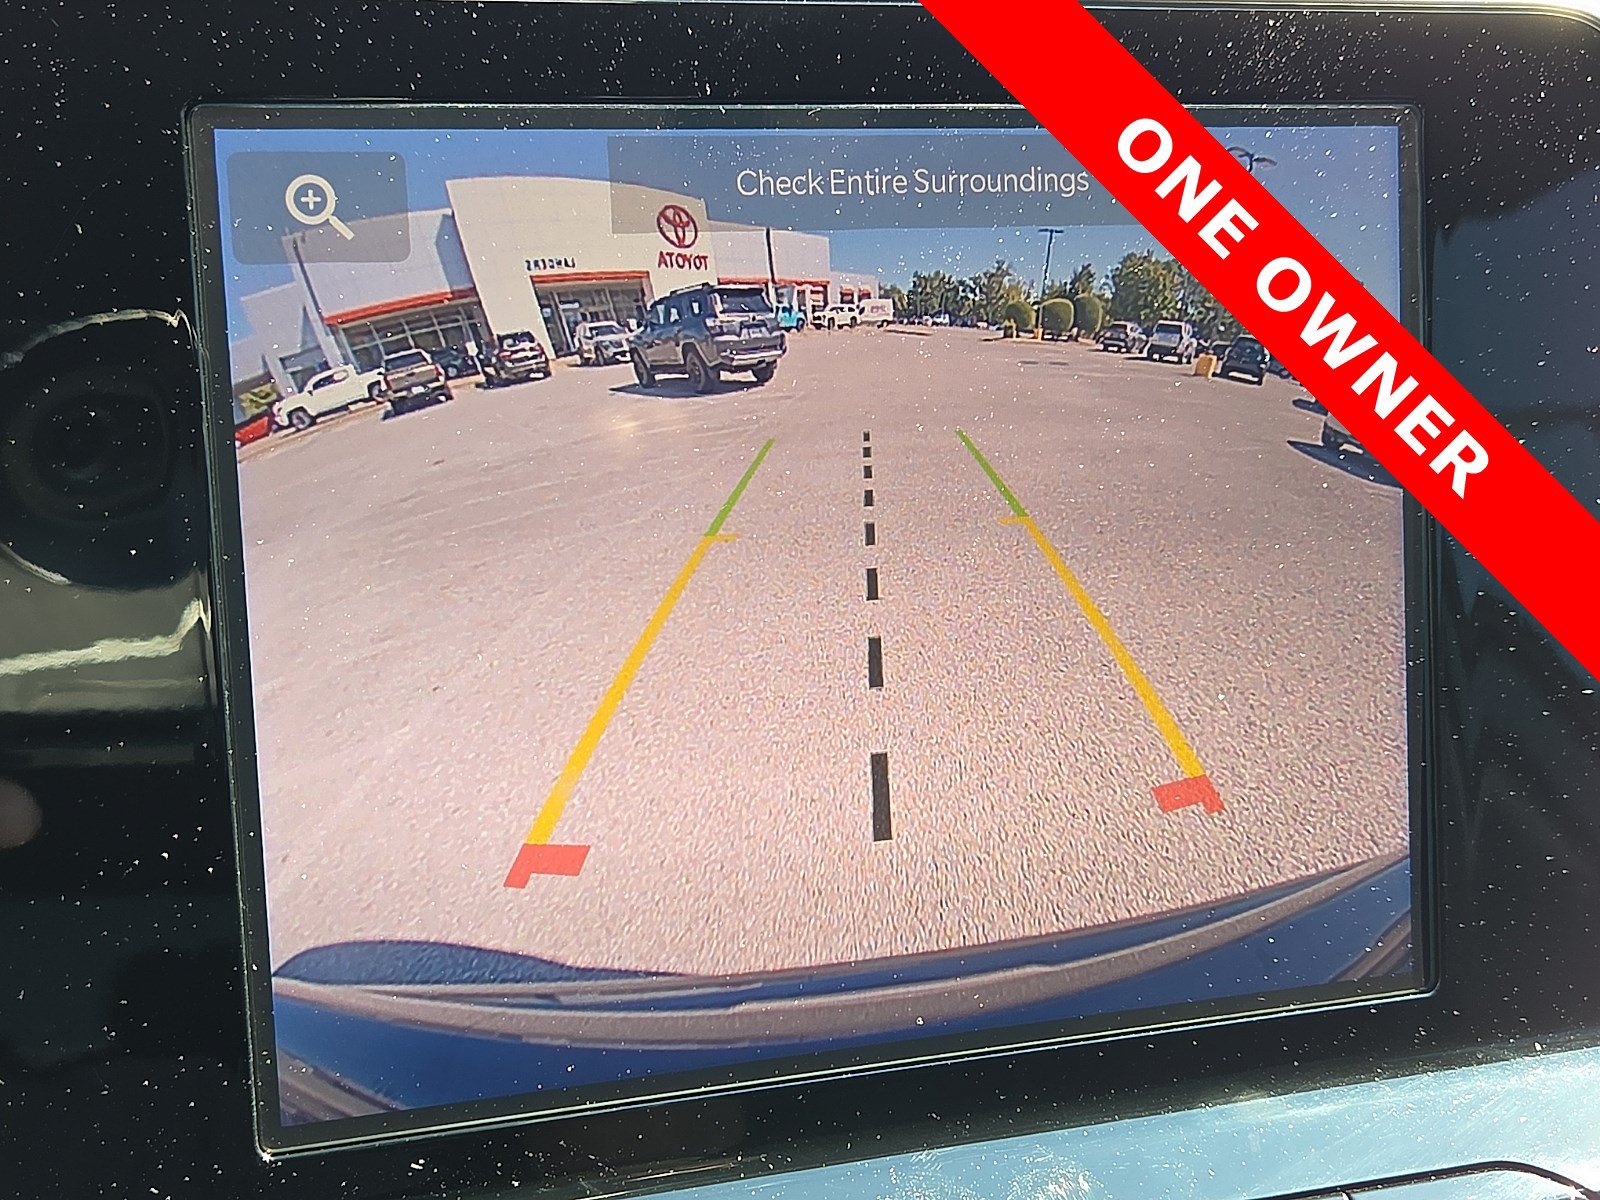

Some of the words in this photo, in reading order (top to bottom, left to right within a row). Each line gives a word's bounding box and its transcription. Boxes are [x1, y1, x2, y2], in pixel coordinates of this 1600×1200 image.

[736, 169, 824, 195] Check
[830, 169, 908, 195] Entire
[914, 167, 1091, 198] Surroundings
